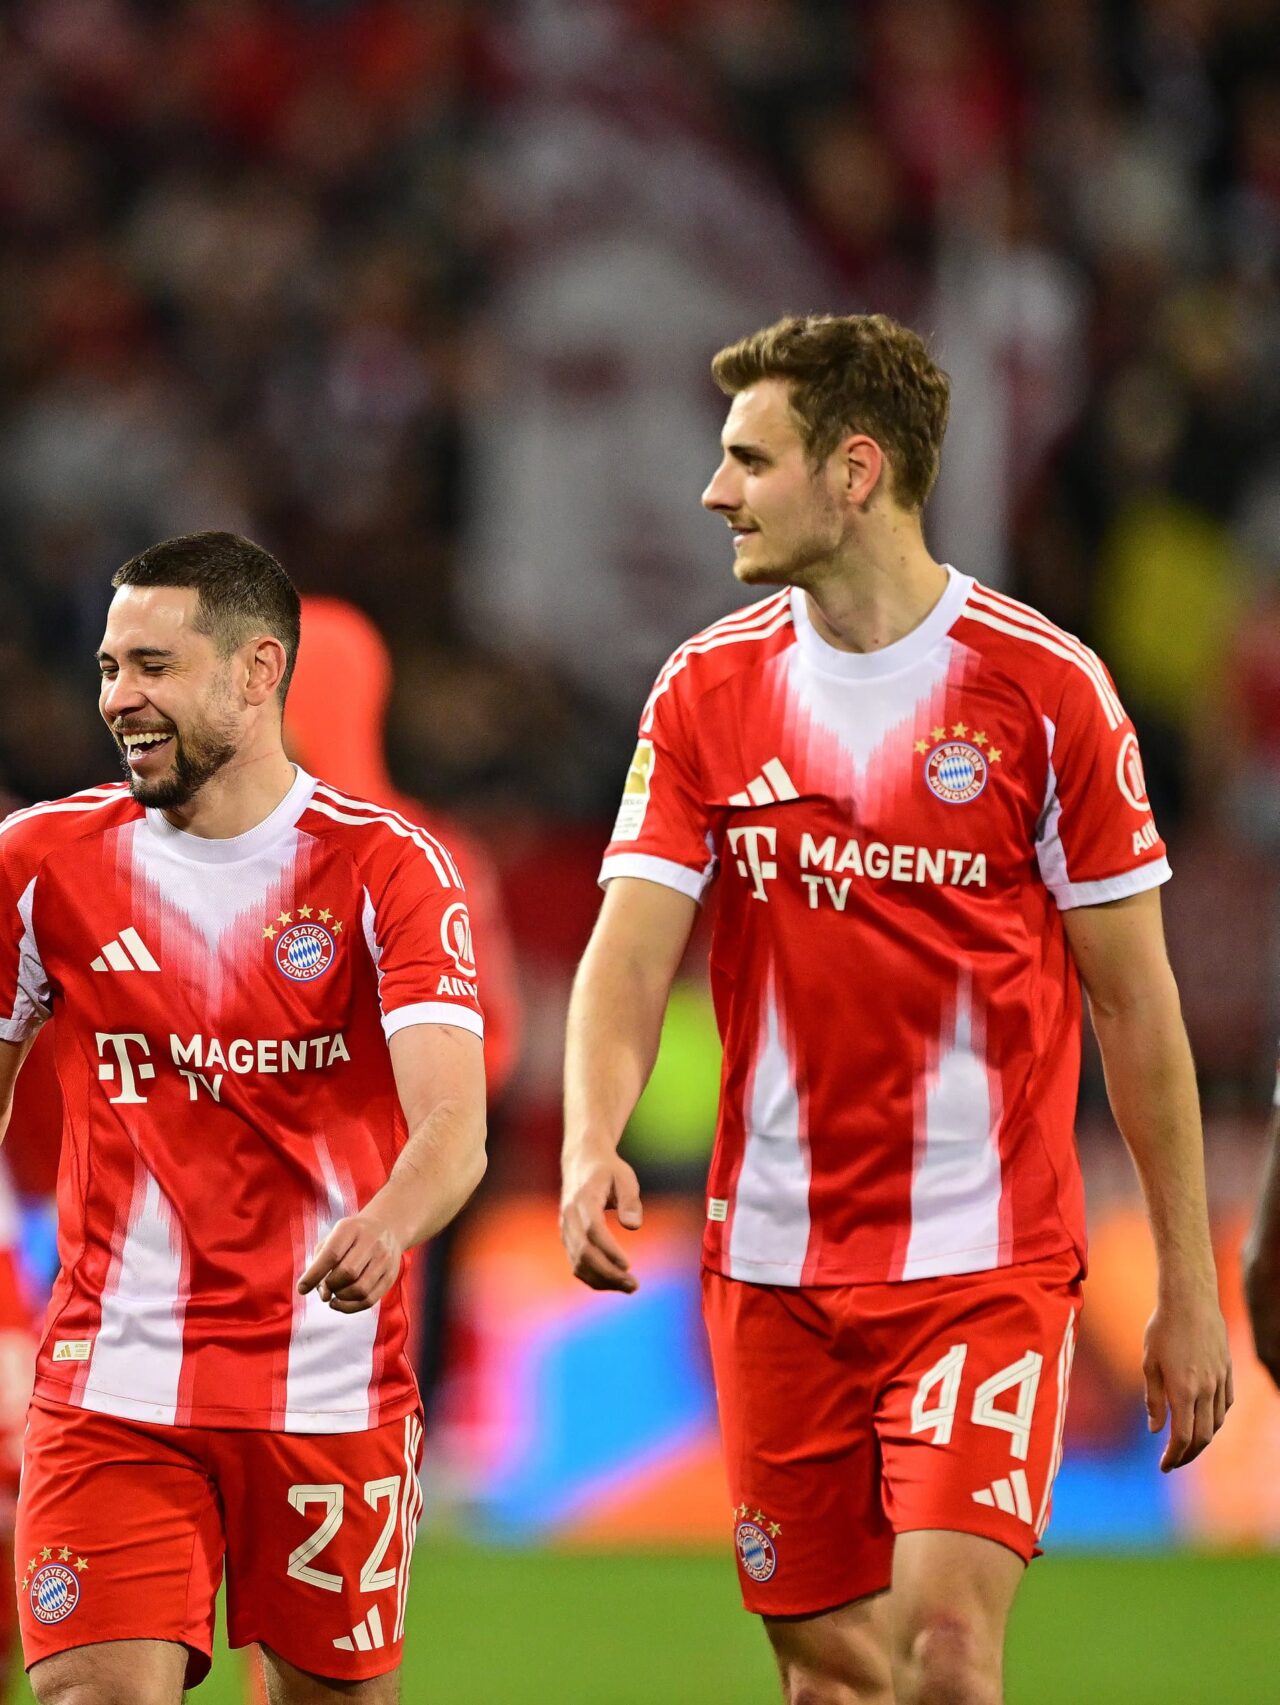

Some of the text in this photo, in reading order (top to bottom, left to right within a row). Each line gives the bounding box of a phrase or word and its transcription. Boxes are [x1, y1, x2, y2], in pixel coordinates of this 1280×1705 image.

[799, 832, 987, 888] MAGENTA
[801, 874, 852, 912] TV
[280, 927, 330, 950] FC BAYERN
[170, 1033, 351, 1075] MAGENTA
[179, 1069, 223, 1103] TV
[910, 1342, 1043, 1462] 44
[287, 1475, 402, 1593] 22
[32, 1568, 73, 1596] FC BAYERN
